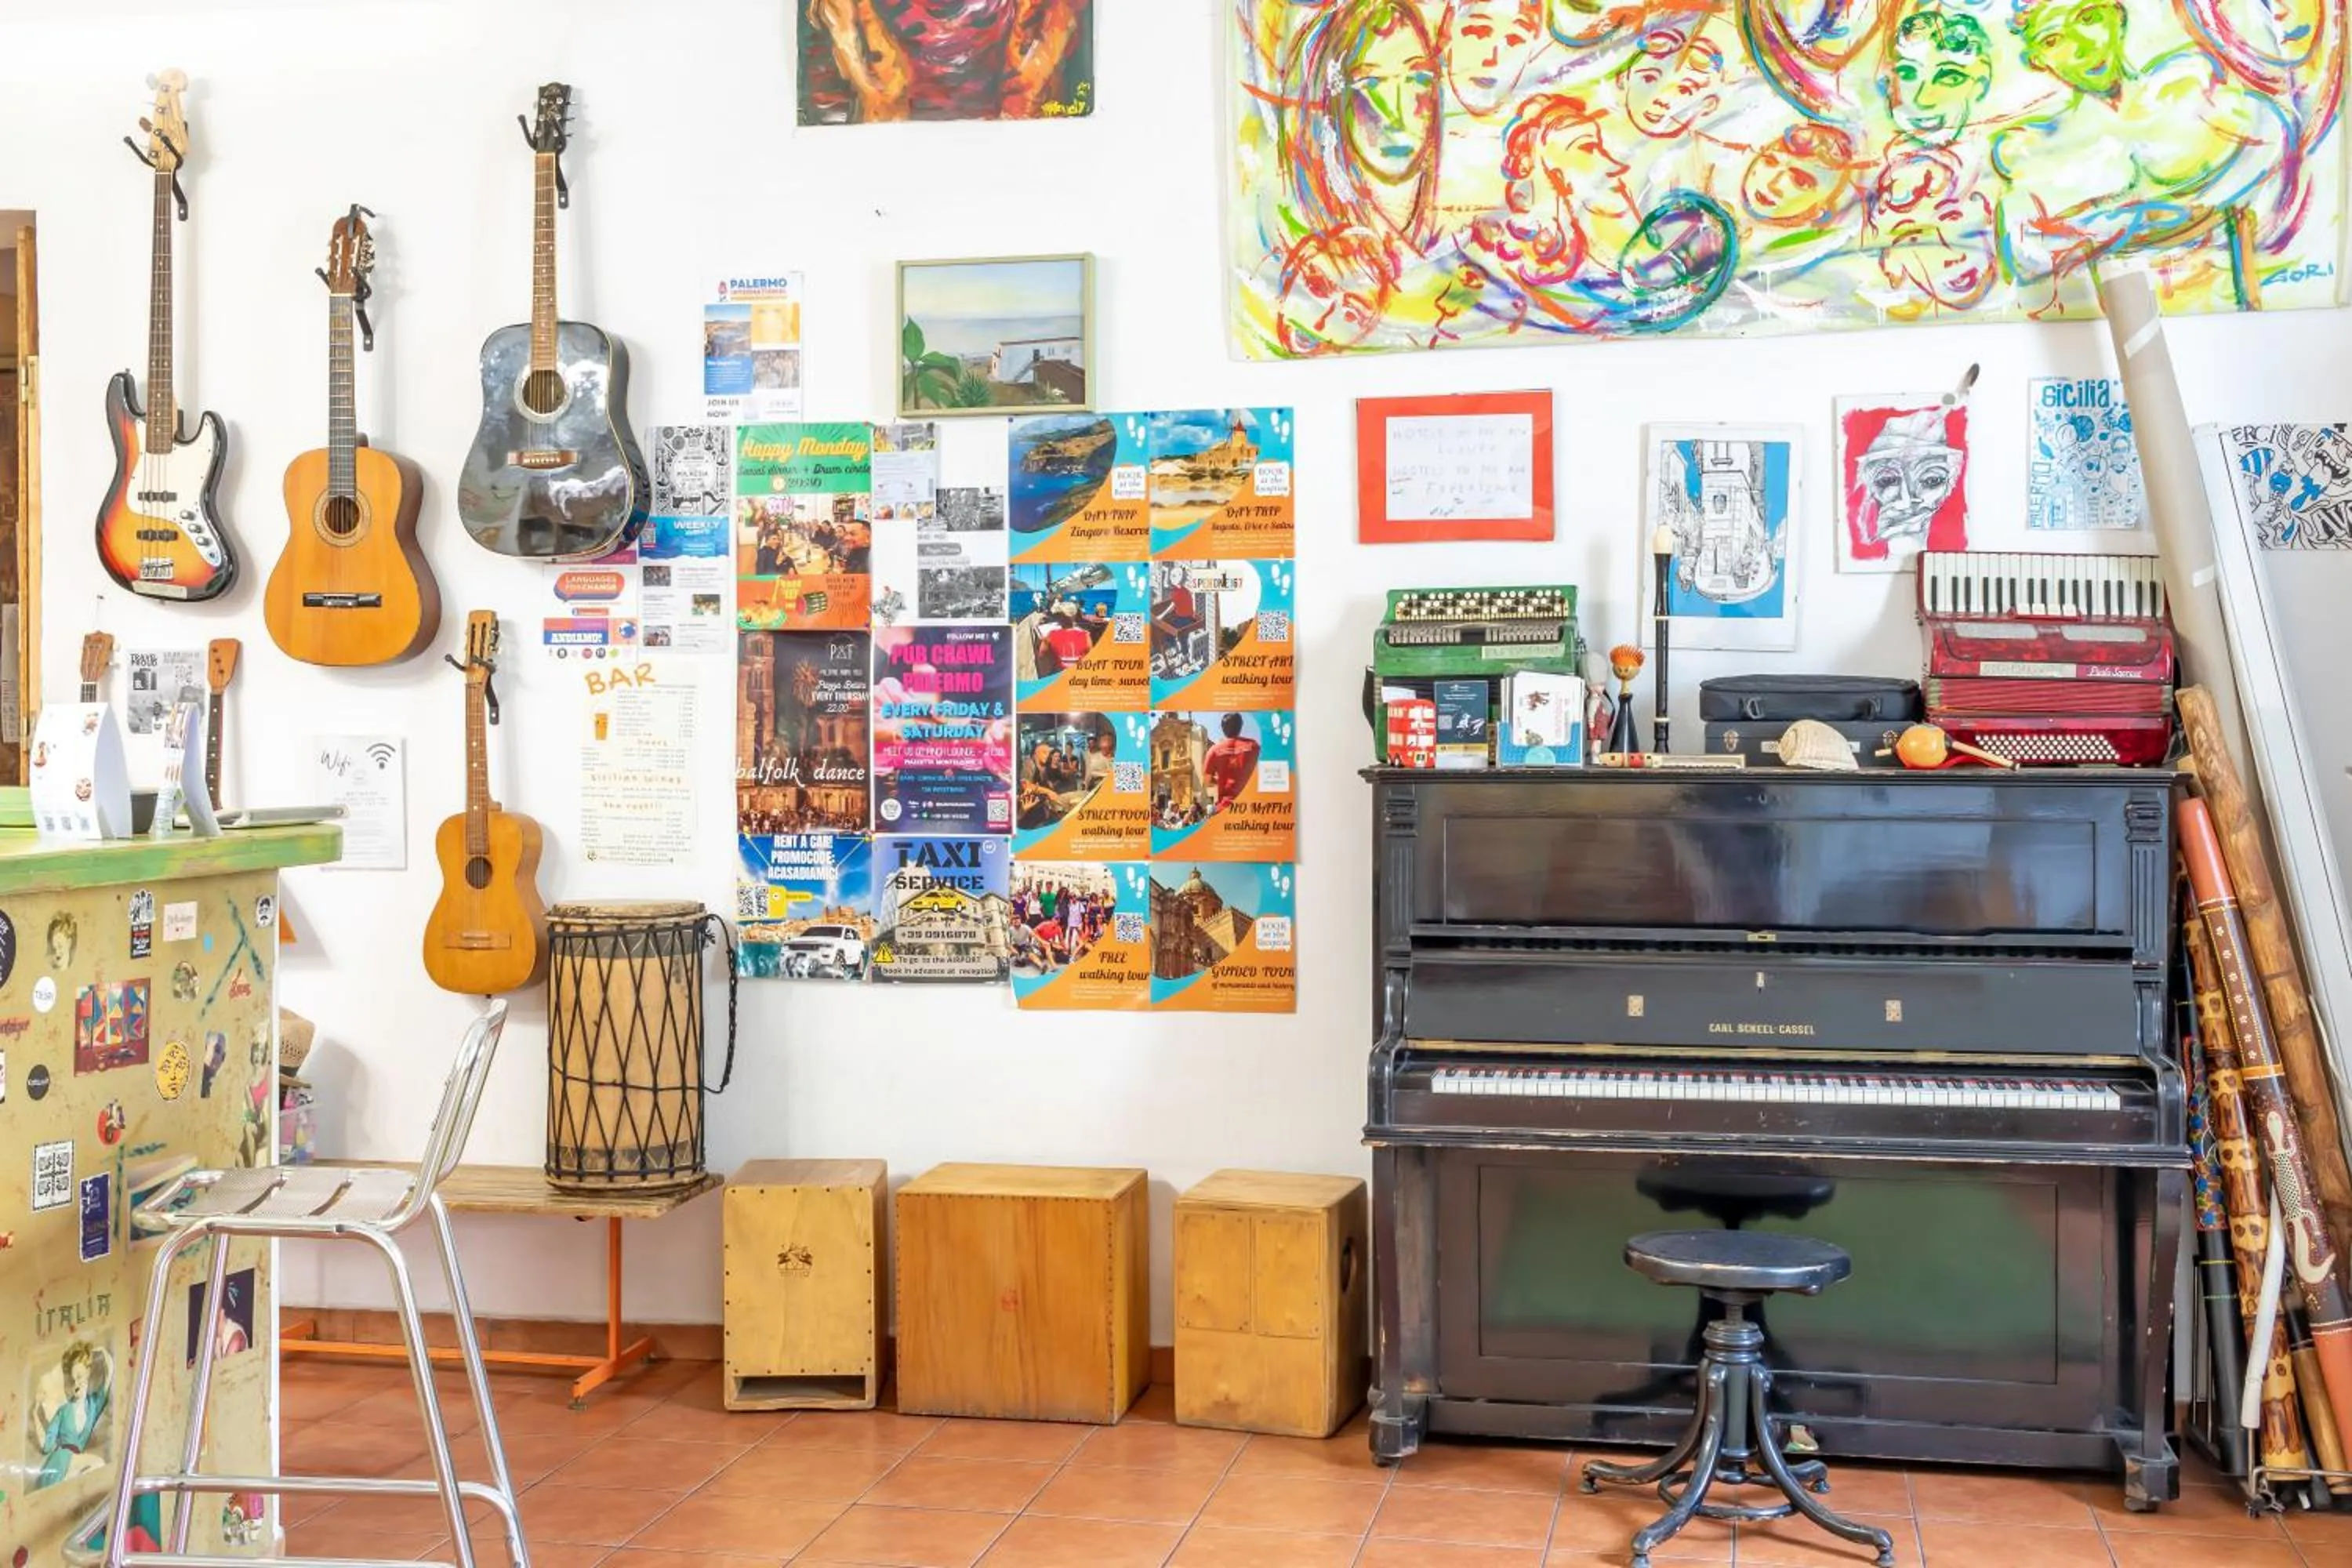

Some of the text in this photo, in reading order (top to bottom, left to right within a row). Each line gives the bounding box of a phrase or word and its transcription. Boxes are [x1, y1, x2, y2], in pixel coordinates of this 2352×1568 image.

[730, 278, 787, 289] PALERMO
[742, 437, 869, 463] Happy Monday
[813, 463, 843, 474] Drum
[1084, 510, 1137, 521] DAY TRIP
[1226, 506, 1283, 519] DAY TRIP
[673, 520, 719, 529] WEEKLY
[891, 644, 995, 666] PUB CRAWL
[1222, 654, 1294, 668] STREET ART
[1076, 659, 1145, 671] BOAT TOUR
[583, 662, 656, 695] BAR
[902, 671, 985, 693] PALERMO
[1069, 677, 1088, 688] day
[1118, 677, 1150, 686] sunset
[1221, 672, 1293, 688] walking tour
[880, 702, 1004, 718] EVERY FRIDAY &
[902, 723, 985, 739] SATURDAY
[736, 755, 866, 787] balfolk dance
[1229, 802, 1293, 815] NO MAFIA
[1081, 826, 1147, 838] walking tour
[1224, 820, 1294, 834] walking tour
[774, 834, 833, 849] RENT A CAR!
[771, 850, 835, 865] PROMOCODE:
[893, 841, 982, 867] TAXI
[895, 875, 985, 890] SERVICE
[1099, 950, 1127, 964] FREE
[958, 967, 996, 975] reception
[1080, 969, 1149, 984] walking tour
[1211, 965, 1294, 978] GUIDED TOUR
[1708, 1022, 1734, 1033] CARL
[1778, 1025, 1815, 1036] CASSEL
[35, 1292, 111, 1336] ITALIA
